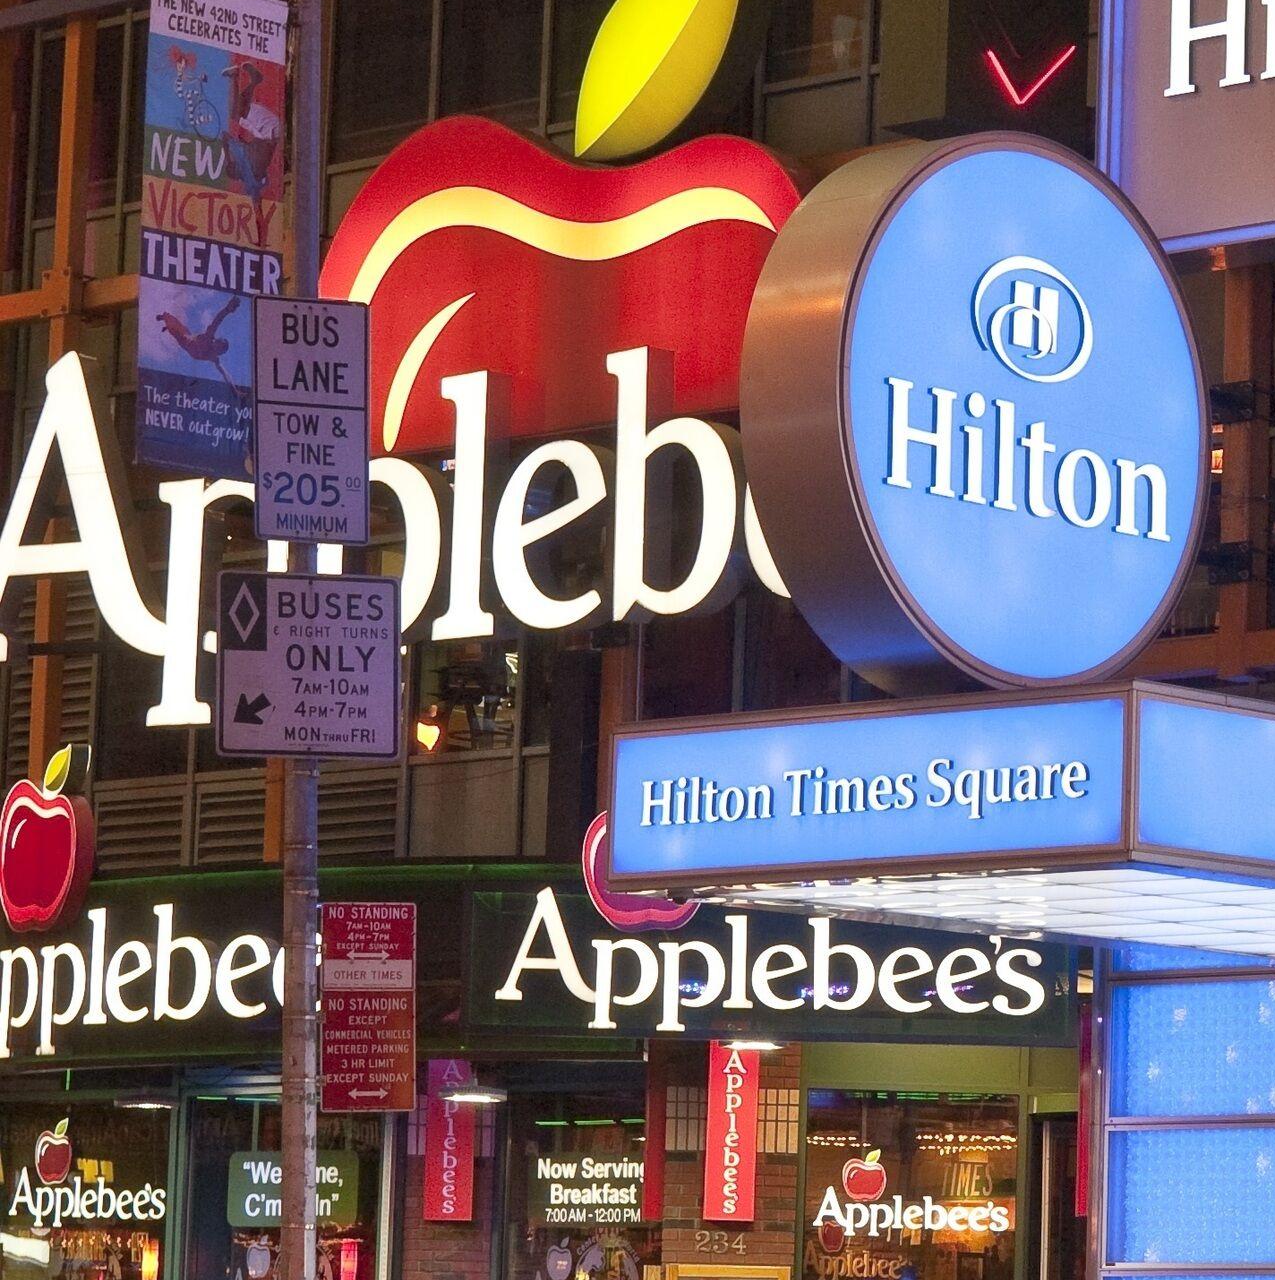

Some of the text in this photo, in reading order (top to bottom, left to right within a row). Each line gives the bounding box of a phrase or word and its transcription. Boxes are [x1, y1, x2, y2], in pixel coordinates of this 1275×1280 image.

[210, 6, 238, 26] 42ND
[168, 13, 270, 54] CELEBRATES THE
[150, 132, 226, 180] NEW
[148, 179, 277, 248] VICTORY
[143, 231, 281, 295] THEATER
[282, 312, 340, 348] BUS
[272, 357, 349, 395] LANE
[143, 385, 170, 406] The
[175, 391, 231, 416] theater
[145, 407, 250, 447] NEVER outgrow!
[273, 412, 348, 438] TOW &
[287, 442, 335, 466] FINE
[882, 378, 1172, 543] Hilton
[276, 513, 347, 534] MINIMUM
[278, 591, 384, 621] BUSES
[290, 625, 331, 639] RIGHT
[342, 627, 389, 640] TURNS
[285, 643, 376, 673] ONLY
[284, 726, 321, 742] MON
[351, 728, 376, 743] FRI
[639, 758, 1089, 827] Hilton Times Square
[328, 906, 408, 920] NO STANDING
[336, 942, 400, 950] EXCEPT SUNDAY
[495, 886, 1046, 1032] Applebee's
[333, 970, 402, 980] OTHER TIMES
[328, 997, 407, 1011] NO STANDING
[348, 1015, 387, 1025] EXCEPT
[325, 1029, 411, 1040] COMMERCIAL VEHICLES
[326, 1043, 409, 1055] METERED PARKING
[341, 1058, 395, 1069] 3 HR LIMIT
[326, 1072, 409, 1083] EXCEPT SUNDAY
[442, 1060, 464, 1214] Aplebee's
[722, 1049, 748, 1214] Applebee's
[537, 1158, 577, 1179] Now
[8, 1166, 166, 1228] Applebee's
[550, 1183, 637, 1205] Breakfast
[545, 1207, 567, 1222] 7:00
[594, 1208, 621, 1222] 12:00
[623, 1208, 641, 1222] PM
[812, 1185, 1010, 1237] Applebee's
[695, 1230, 747, 1255] 234
